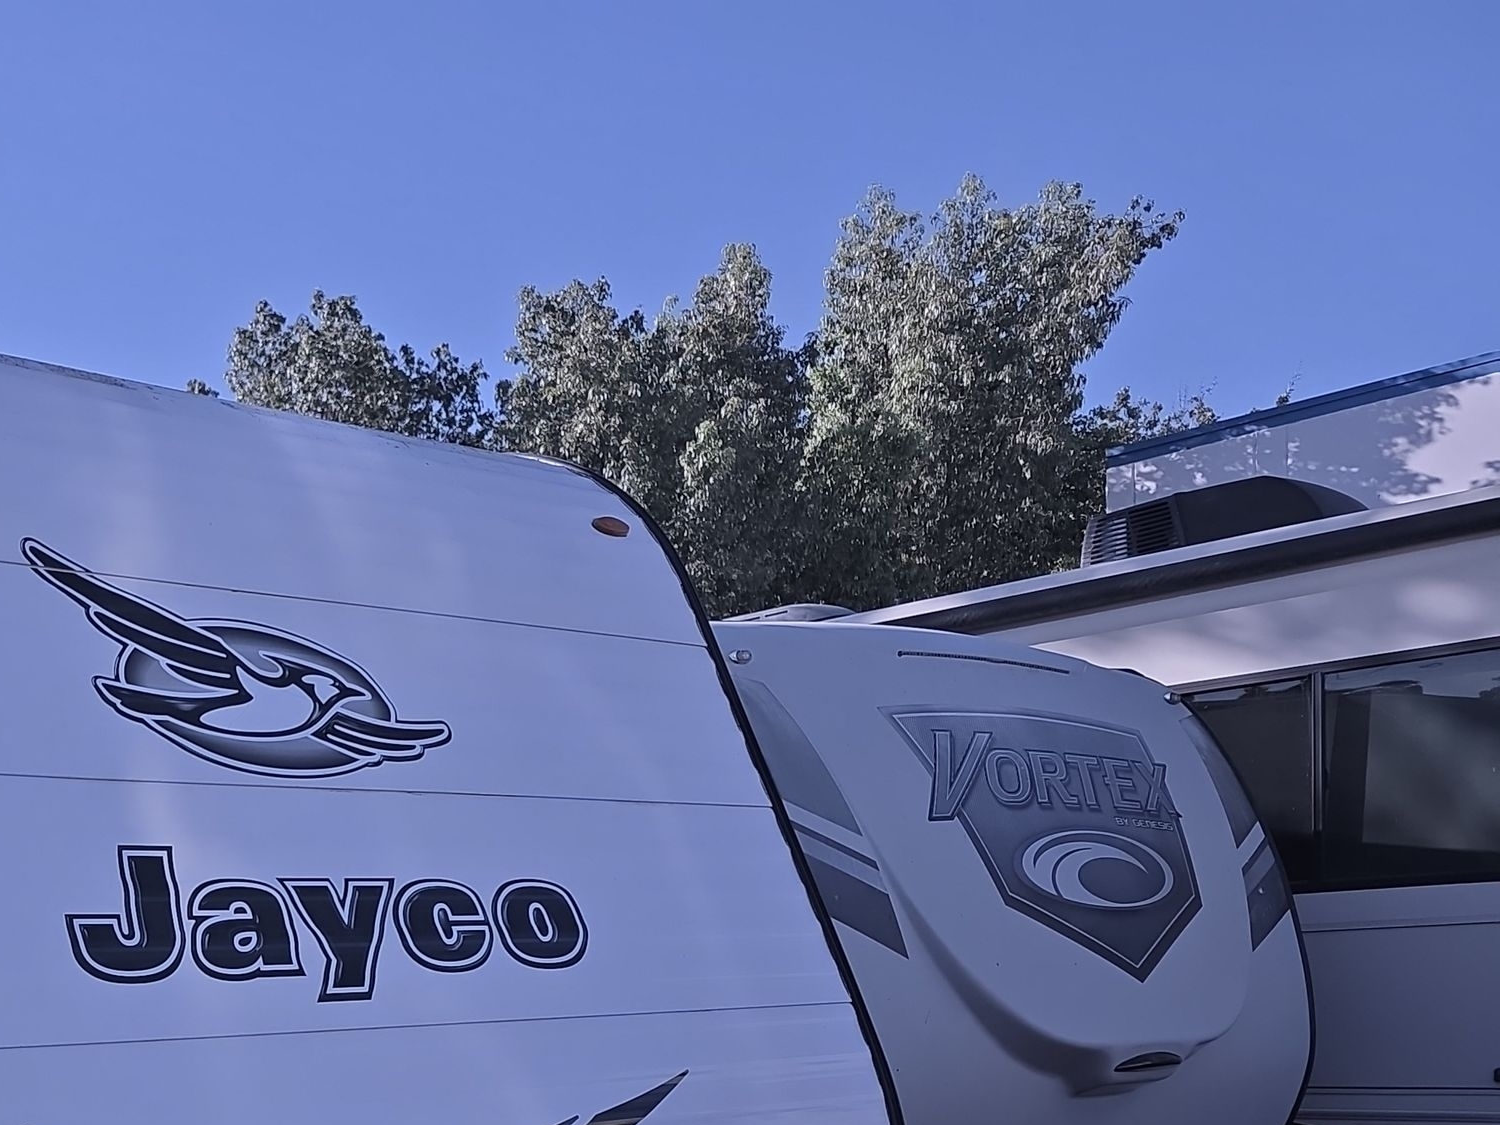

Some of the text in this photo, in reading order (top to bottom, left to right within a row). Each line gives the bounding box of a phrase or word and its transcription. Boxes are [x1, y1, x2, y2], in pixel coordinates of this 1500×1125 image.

[928, 729, 1182, 822] VORTEX
[1114, 816, 1129, 826] BY
[64, 844, 589, 1003] Jayco
